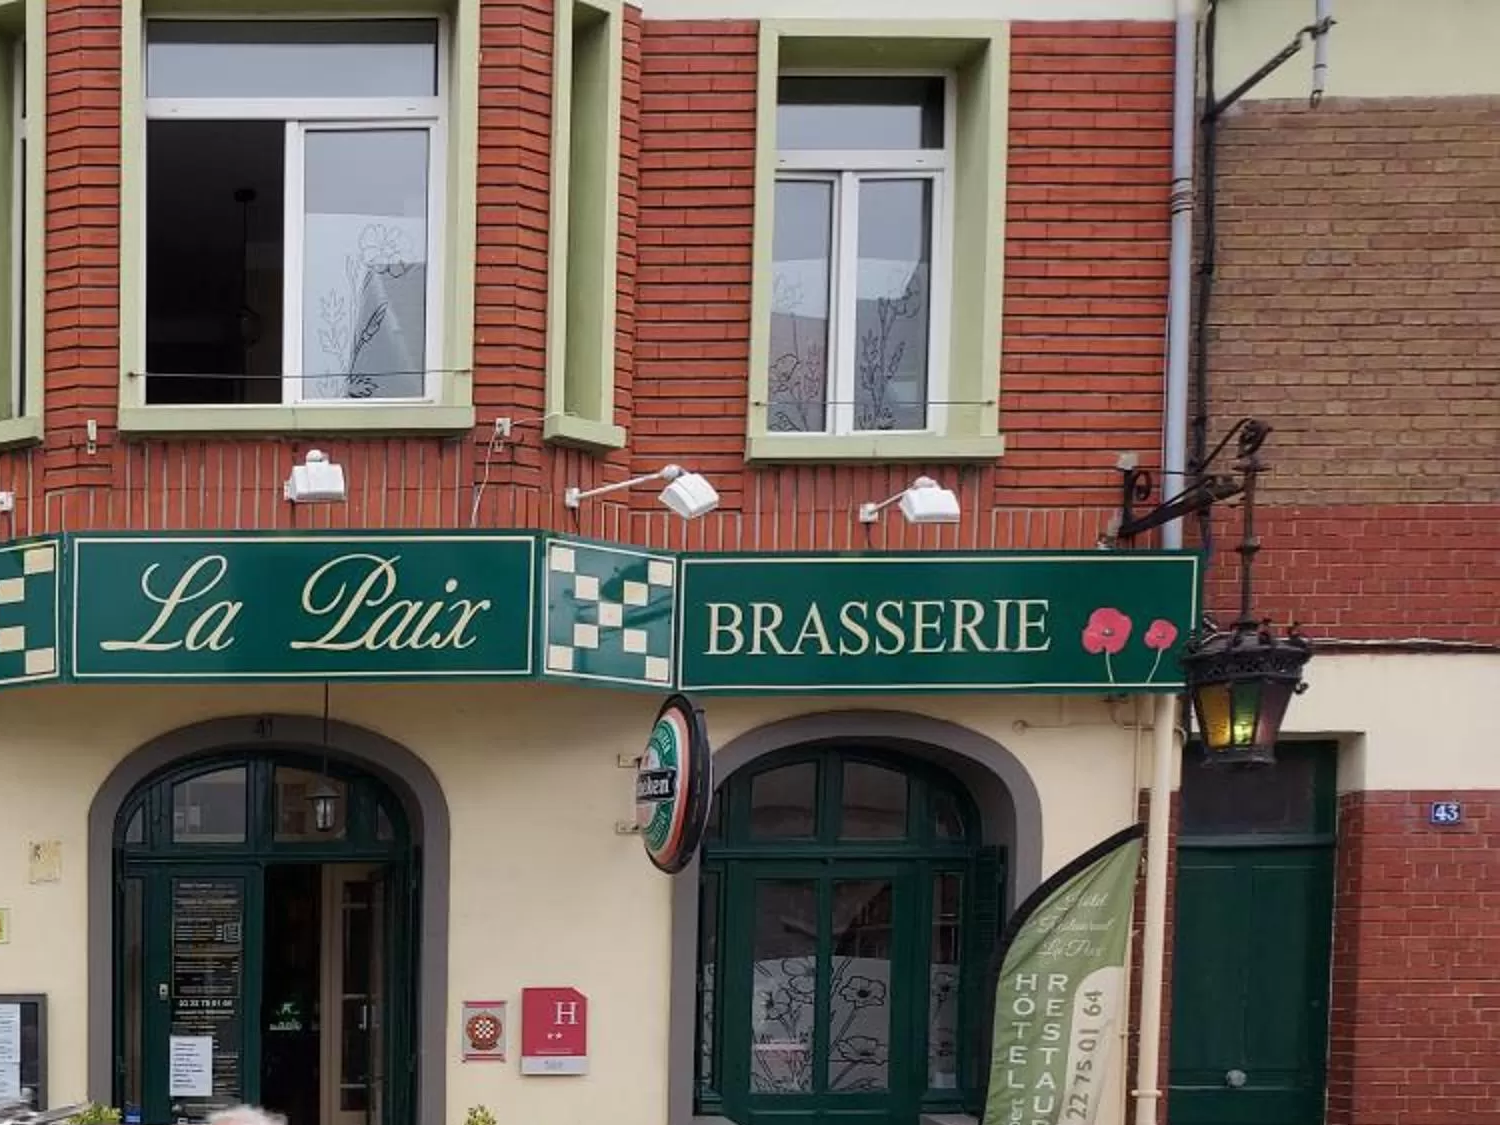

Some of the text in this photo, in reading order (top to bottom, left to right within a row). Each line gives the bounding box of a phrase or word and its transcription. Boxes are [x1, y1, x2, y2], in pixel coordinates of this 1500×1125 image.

[100, 553, 491, 651] La Paix
[705, 599, 1050, 656] BRASSERIE
[1435, 804, 1459, 821] 43
[554, 1001, 579, 1025] H
[1082, 990, 1103, 1017] 64
[1077, 1028, 1100, 1053] 01
[1073, 1059, 1093, 1088] 75
[1066, 1092, 1090, 1121] 22
